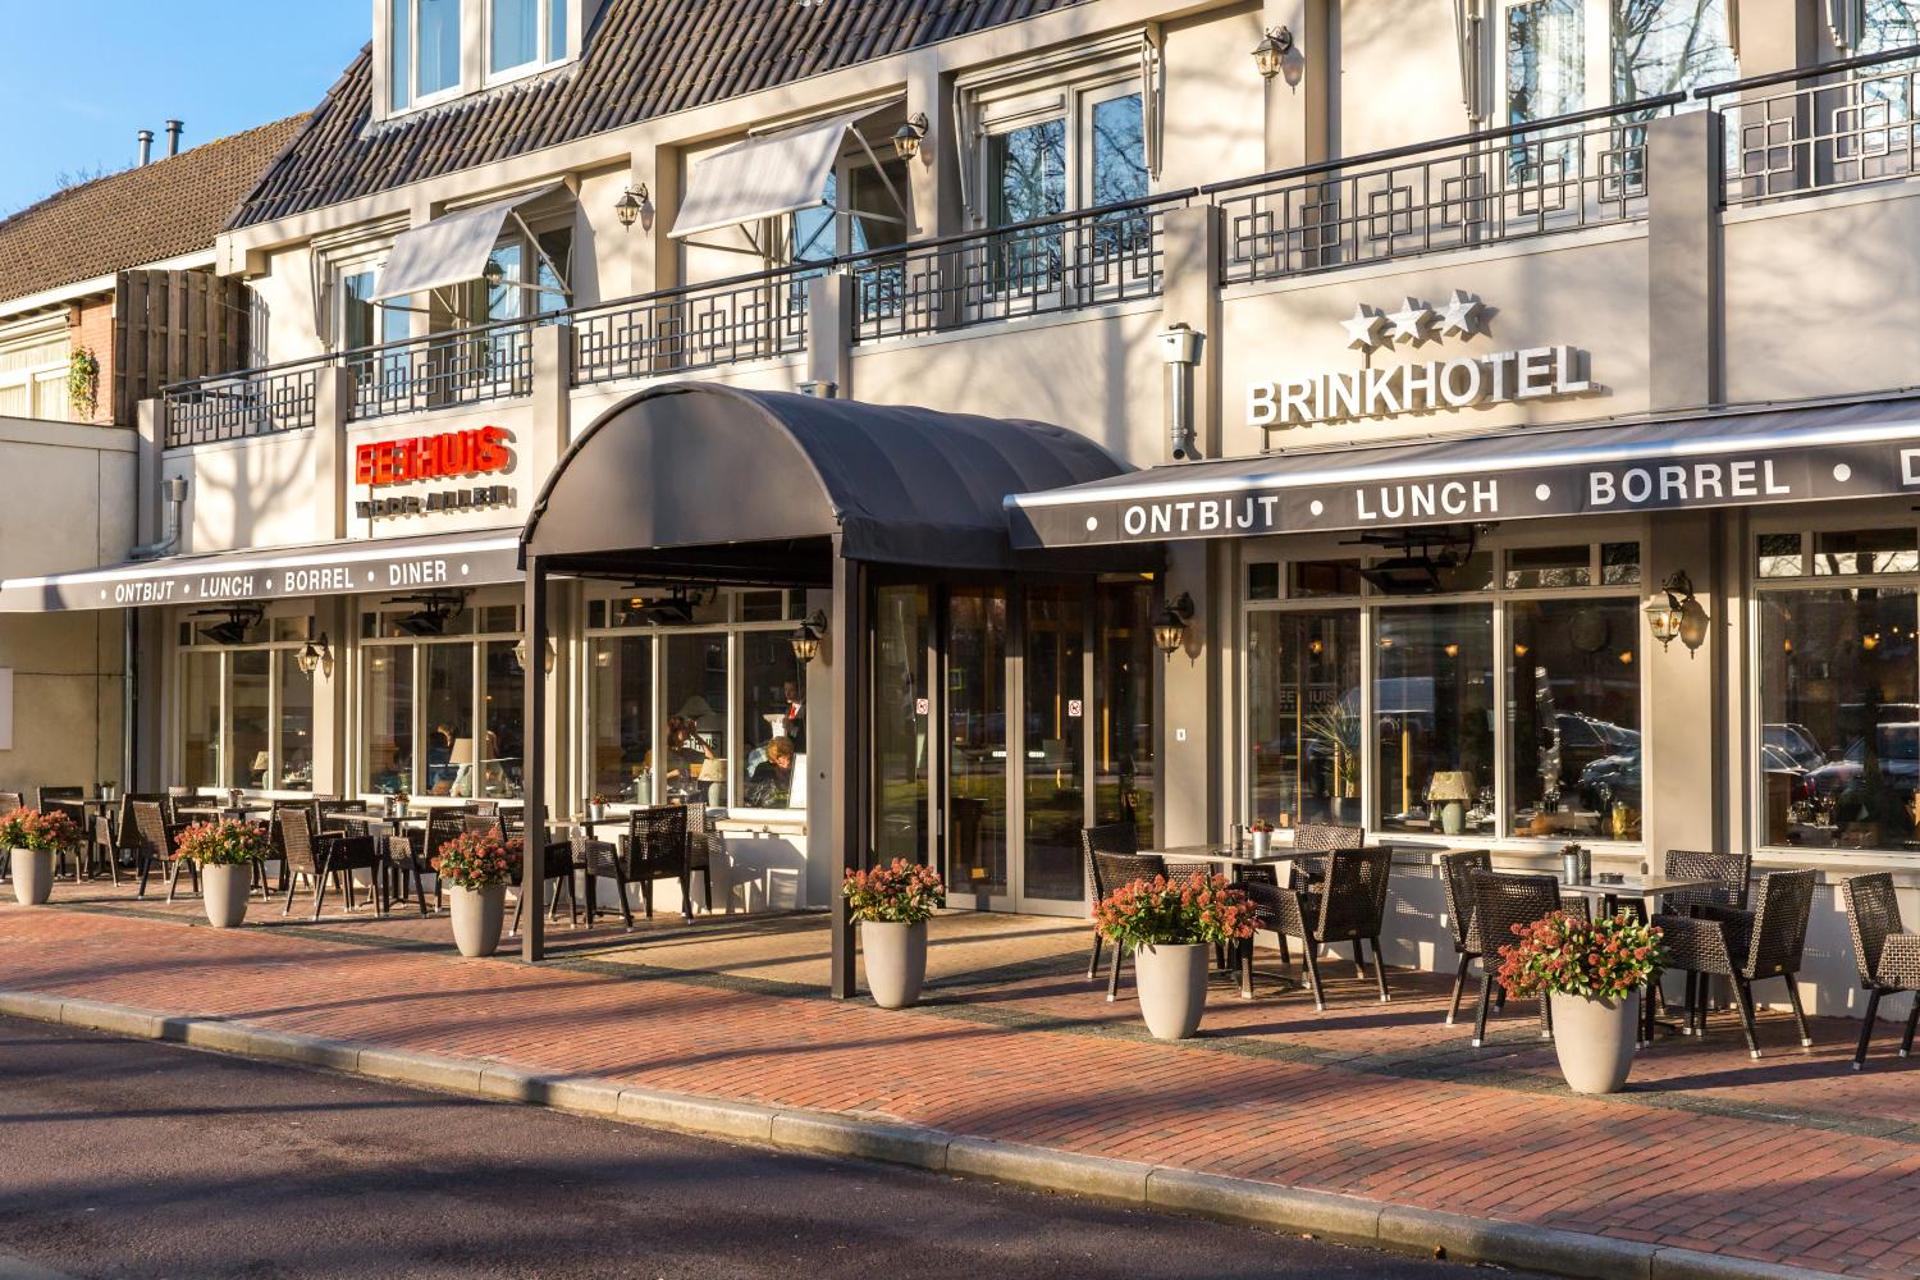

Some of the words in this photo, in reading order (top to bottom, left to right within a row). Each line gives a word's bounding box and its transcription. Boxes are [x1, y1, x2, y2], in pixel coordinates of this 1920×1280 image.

[1246, 344, 1589, 426] BRINKHOTEL
[356, 426, 509, 485] EETHUIS
[1124, 495, 1279, 536] ONTBIJT
[1356, 479, 1499, 521] LUNCH
[1589, 459, 1791, 506] BORREL
[114, 580, 175, 603] ONTBIJT
[199, 575, 254, 598] LUNCH
[284, 567, 356, 593] BORREL
[388, 560, 448, 586] DINER
